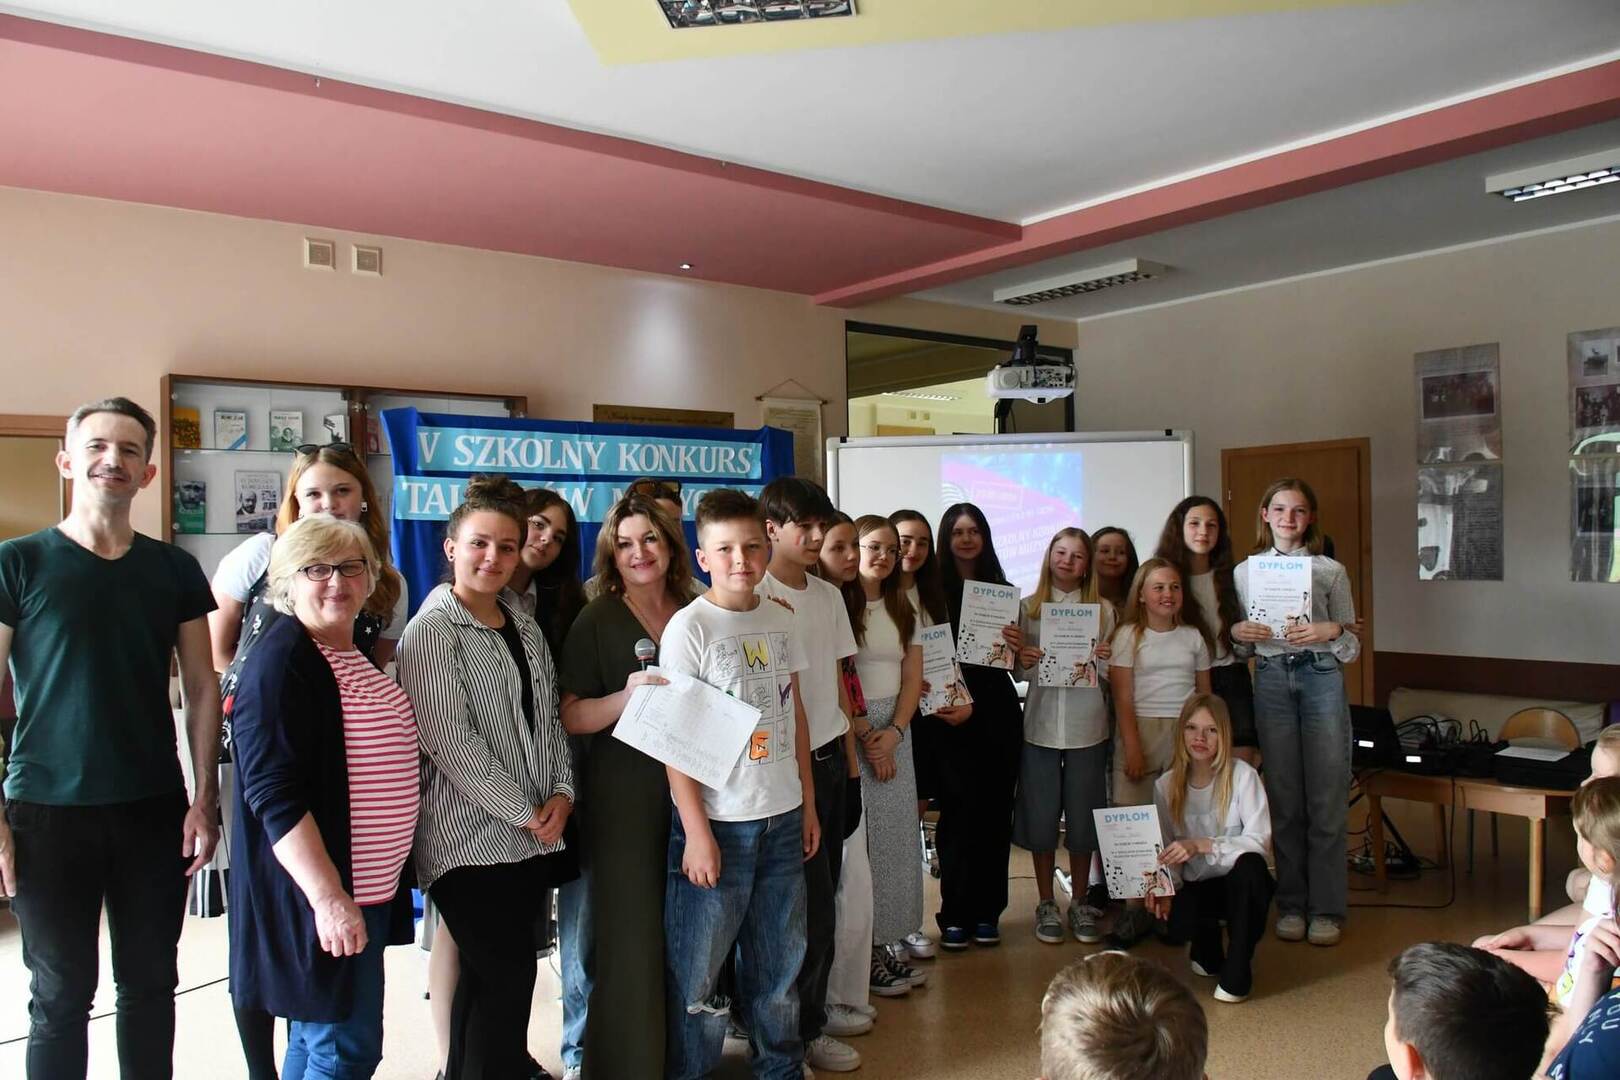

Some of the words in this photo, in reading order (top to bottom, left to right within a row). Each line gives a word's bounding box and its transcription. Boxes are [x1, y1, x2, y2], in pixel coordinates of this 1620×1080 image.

[418, 431, 442, 464] V
[453, 434, 607, 470] SZKOLNY
[619, 443, 753, 473] KONKURS
[1259, 561, 1304, 570] DYPLOM
[973, 586, 1014, 599] DYPLOM
[1051, 608, 1093, 617] DYPLOM
[921, 630, 946, 641] PLOM
[1105, 812, 1150, 823] DYPLOM
